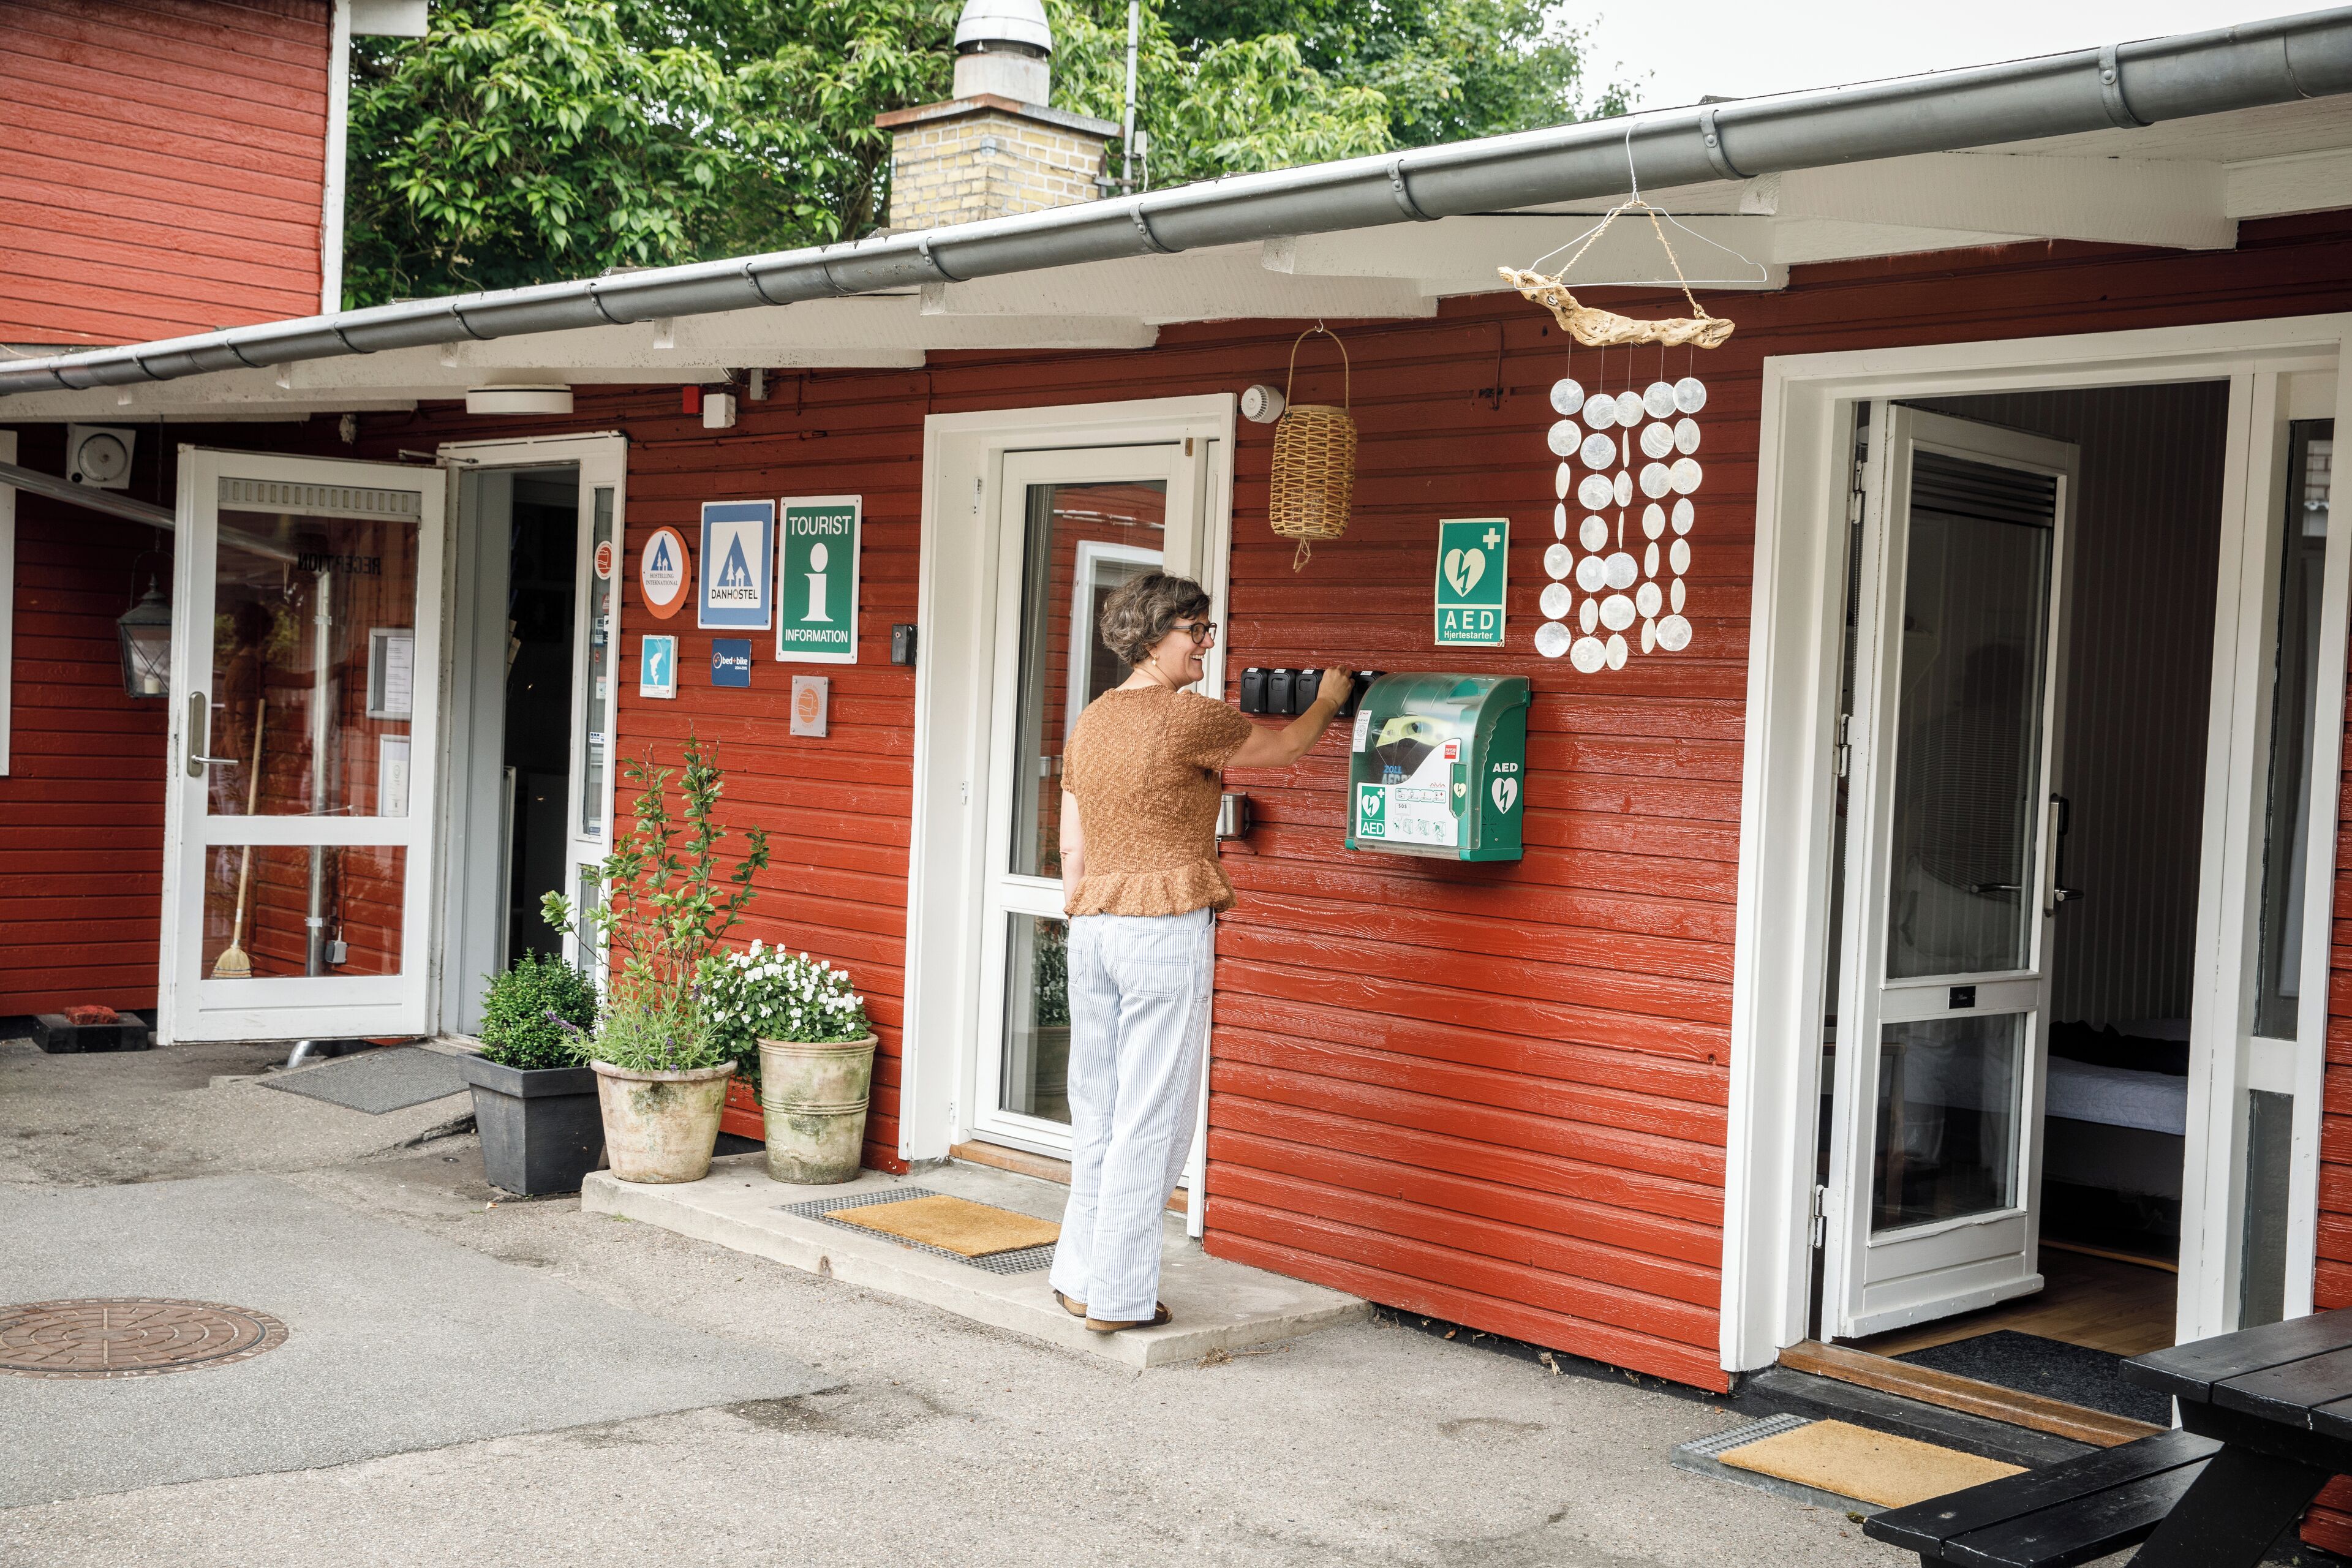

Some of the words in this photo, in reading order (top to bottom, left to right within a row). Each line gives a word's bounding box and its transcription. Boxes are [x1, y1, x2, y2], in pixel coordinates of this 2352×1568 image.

[789, 516, 852, 535] TOURIST
[711, 589, 758, 600] DANHOSTEL
[1444, 611, 1494, 630] AED
[785, 628, 848, 643] INFORMATION
[1444, 630, 1493, 641] Hjertestarter
[1382, 765, 1402, 774] ZOLL
[1492, 763, 1518, 772] AED
[1362, 821, 1385, 835] AED
